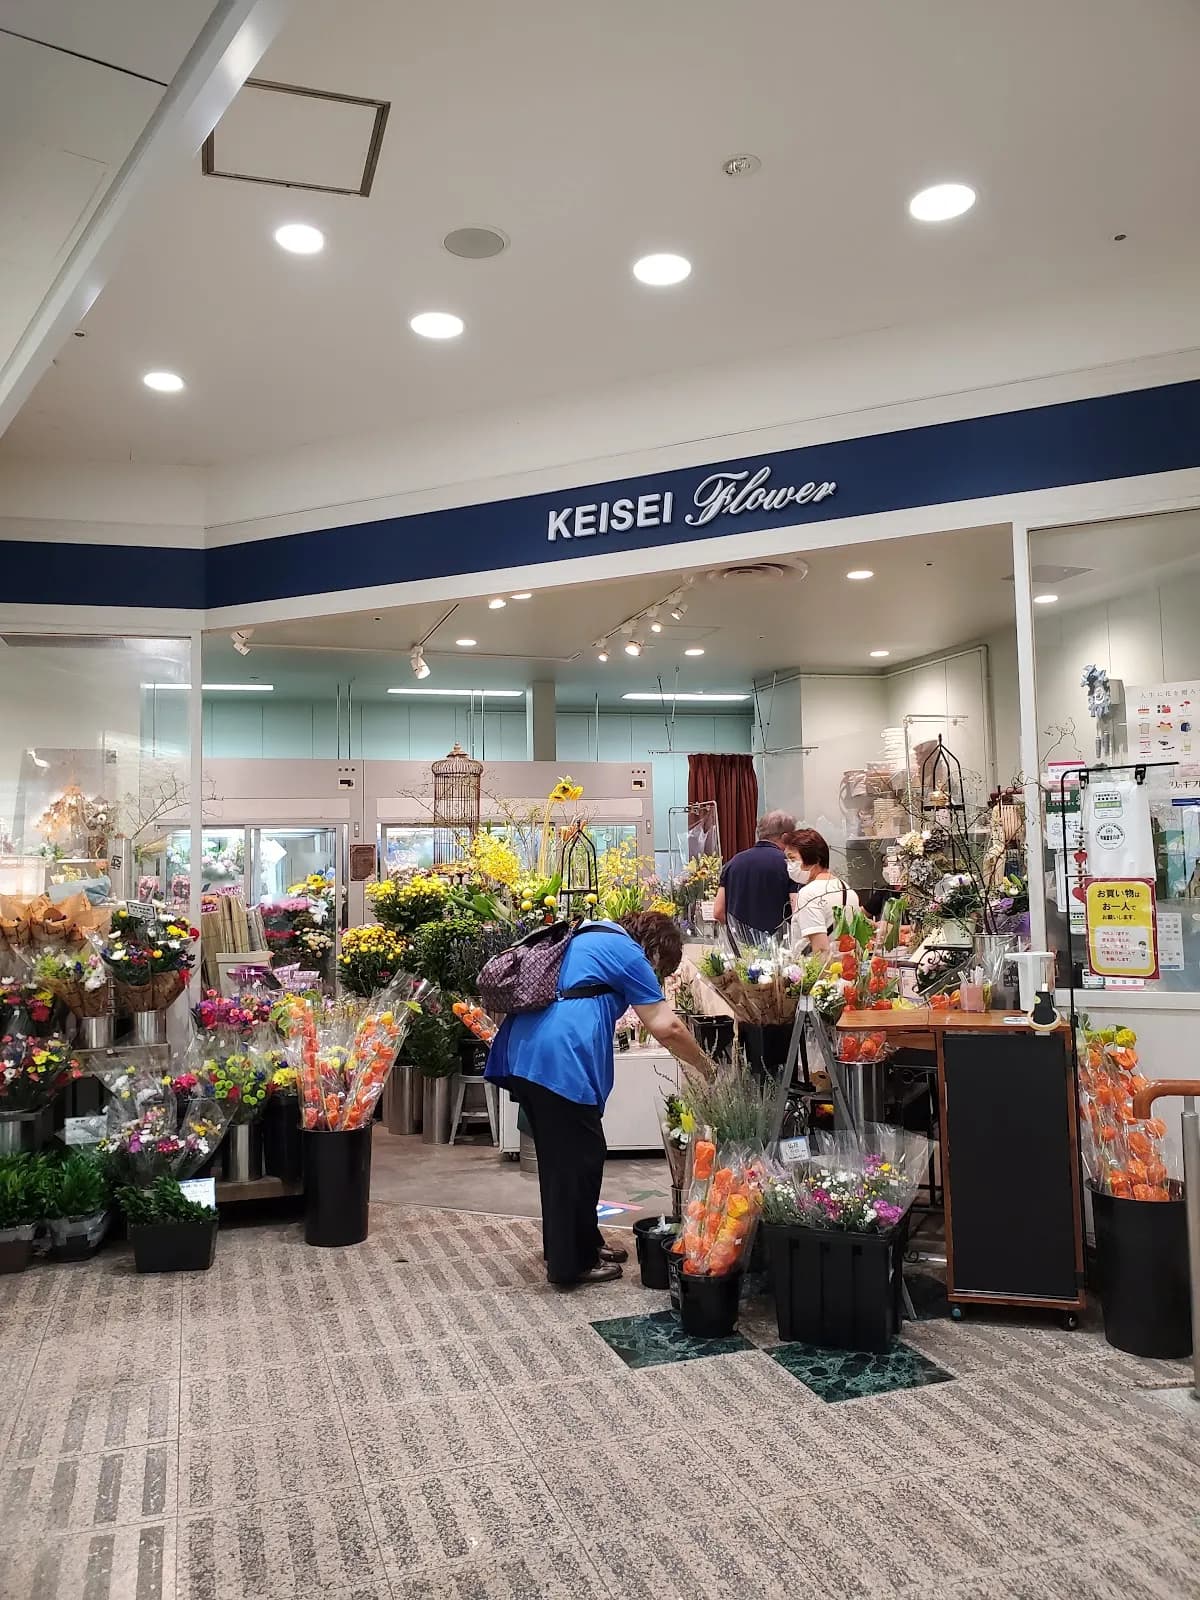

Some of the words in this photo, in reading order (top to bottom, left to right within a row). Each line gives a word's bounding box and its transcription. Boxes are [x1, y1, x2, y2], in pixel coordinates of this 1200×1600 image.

[547, 491, 673, 541] KEISEI
[684, 466, 836, 526] Flower
[1097, 889, 1140, 898] お買い物は
[1102, 902, 1137, 911] お一人で
